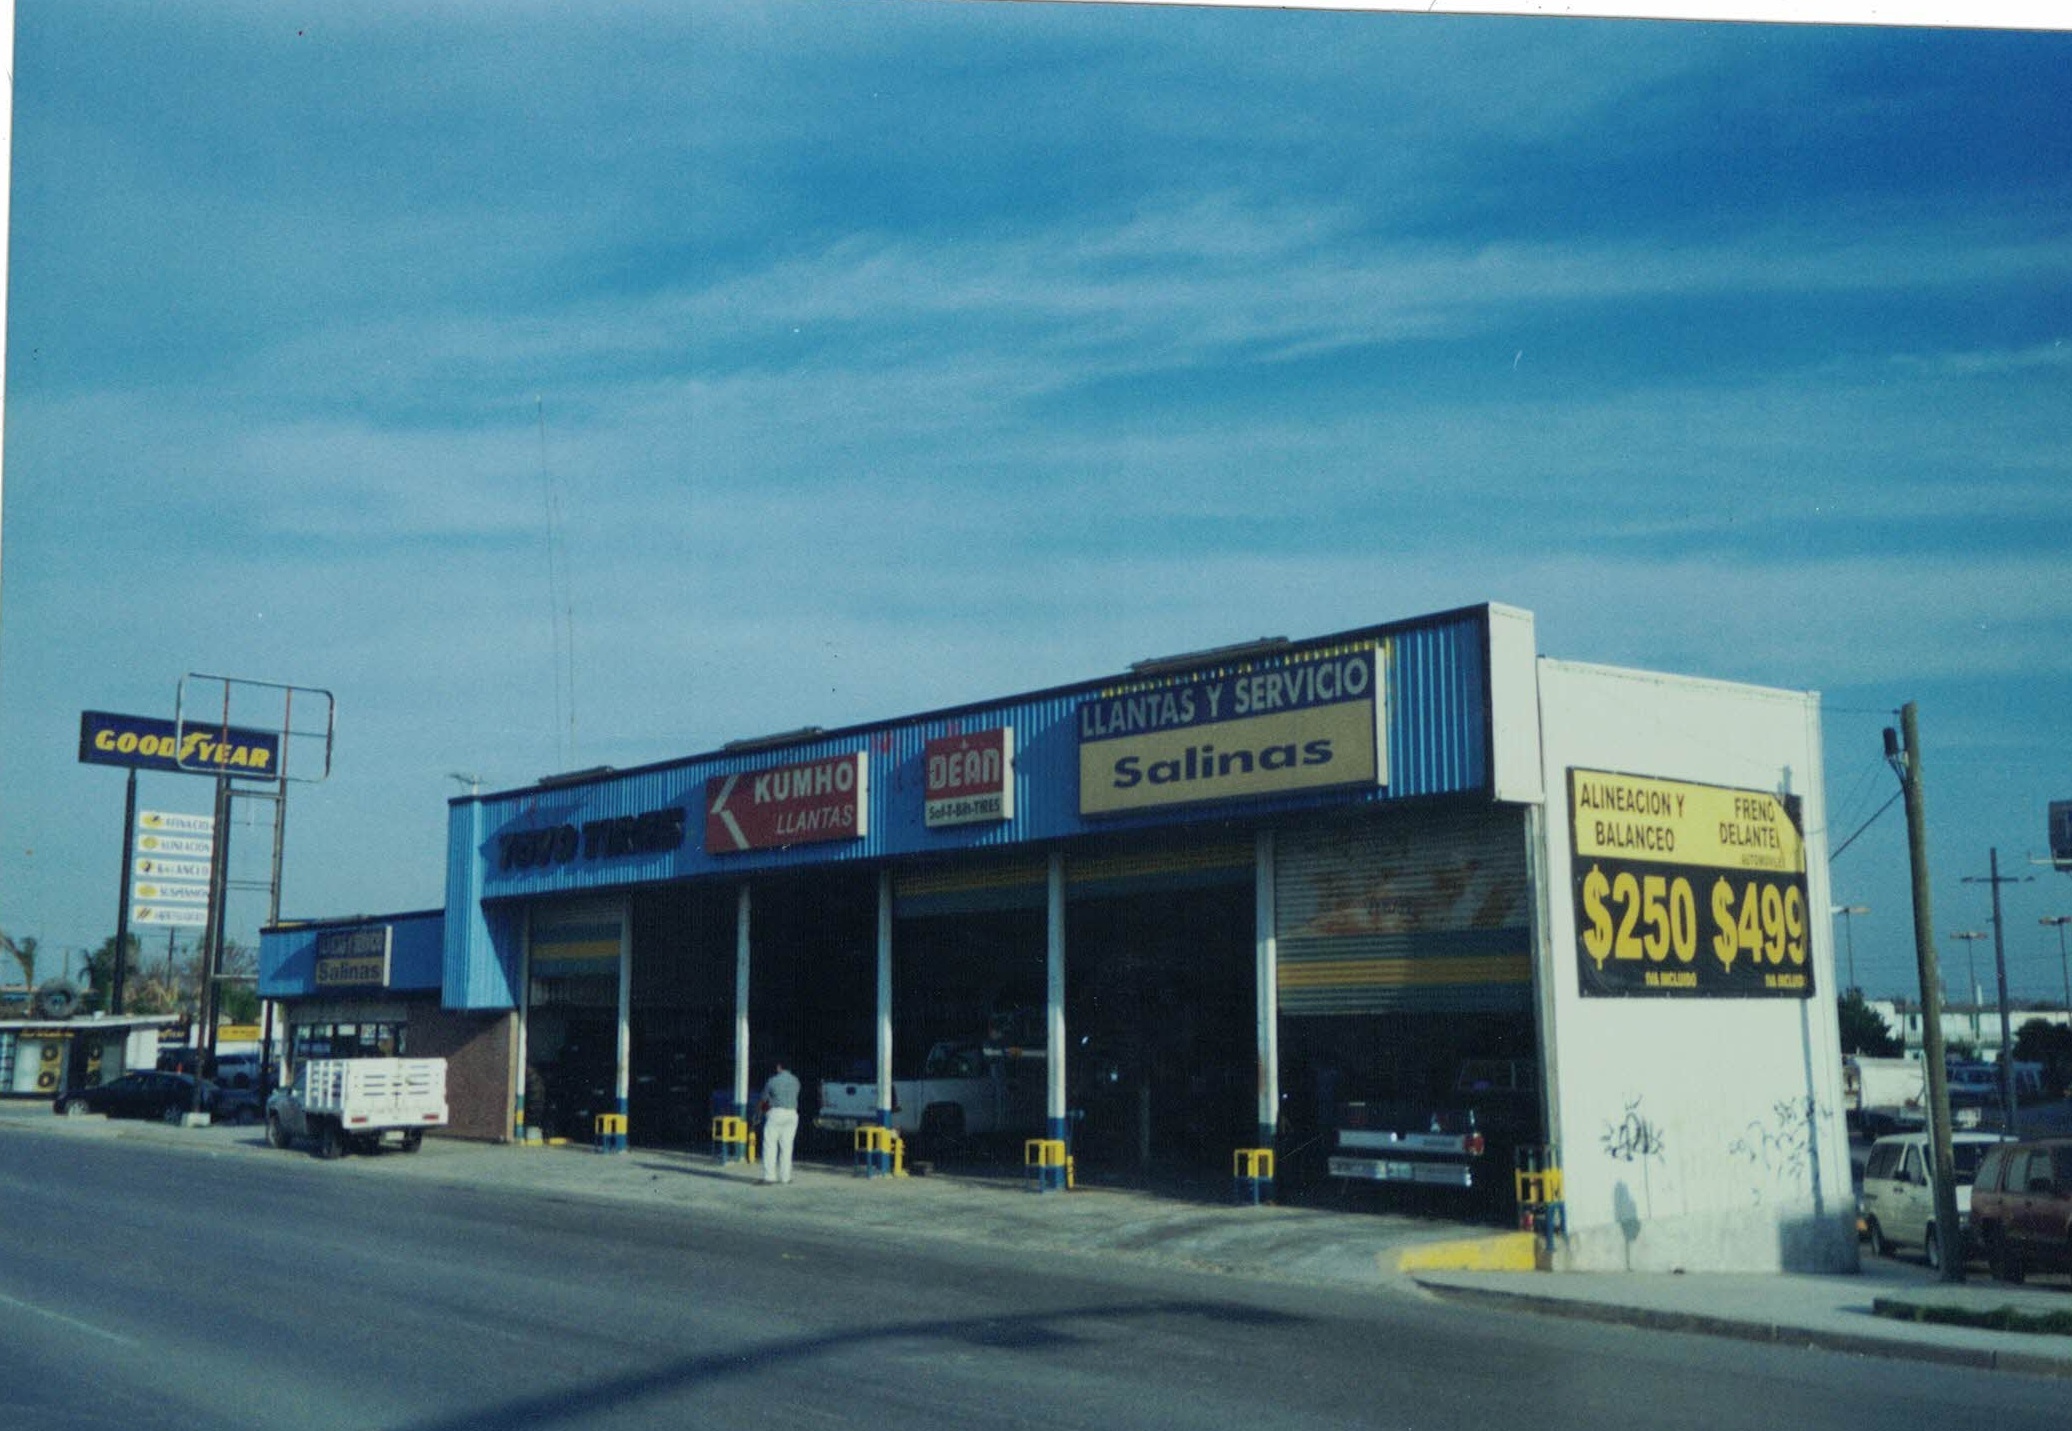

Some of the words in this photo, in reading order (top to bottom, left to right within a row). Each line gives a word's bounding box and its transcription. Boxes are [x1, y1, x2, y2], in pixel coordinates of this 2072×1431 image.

[1082, 687, 1195, 737] LLANTAS
[1206, 683, 1222, 718] Y
[1235, 657, 1369, 714] SERVICIO
[95, 729, 270, 768] GOODYEAR
[929, 748, 1000, 790] DEAN
[1112, 738, 1334, 788] Salinas
[754, 761, 854, 805] KUMHO
[1580, 782, 1671, 817] ALINEACION
[1676, 793, 1685, 818] Y
[775, 804, 854, 834] LLANTAS
[1595, 820, 1675, 852] BALANCEO
[1583, 863, 1697, 971] $250
[1711, 875, 1807, 974] $499
